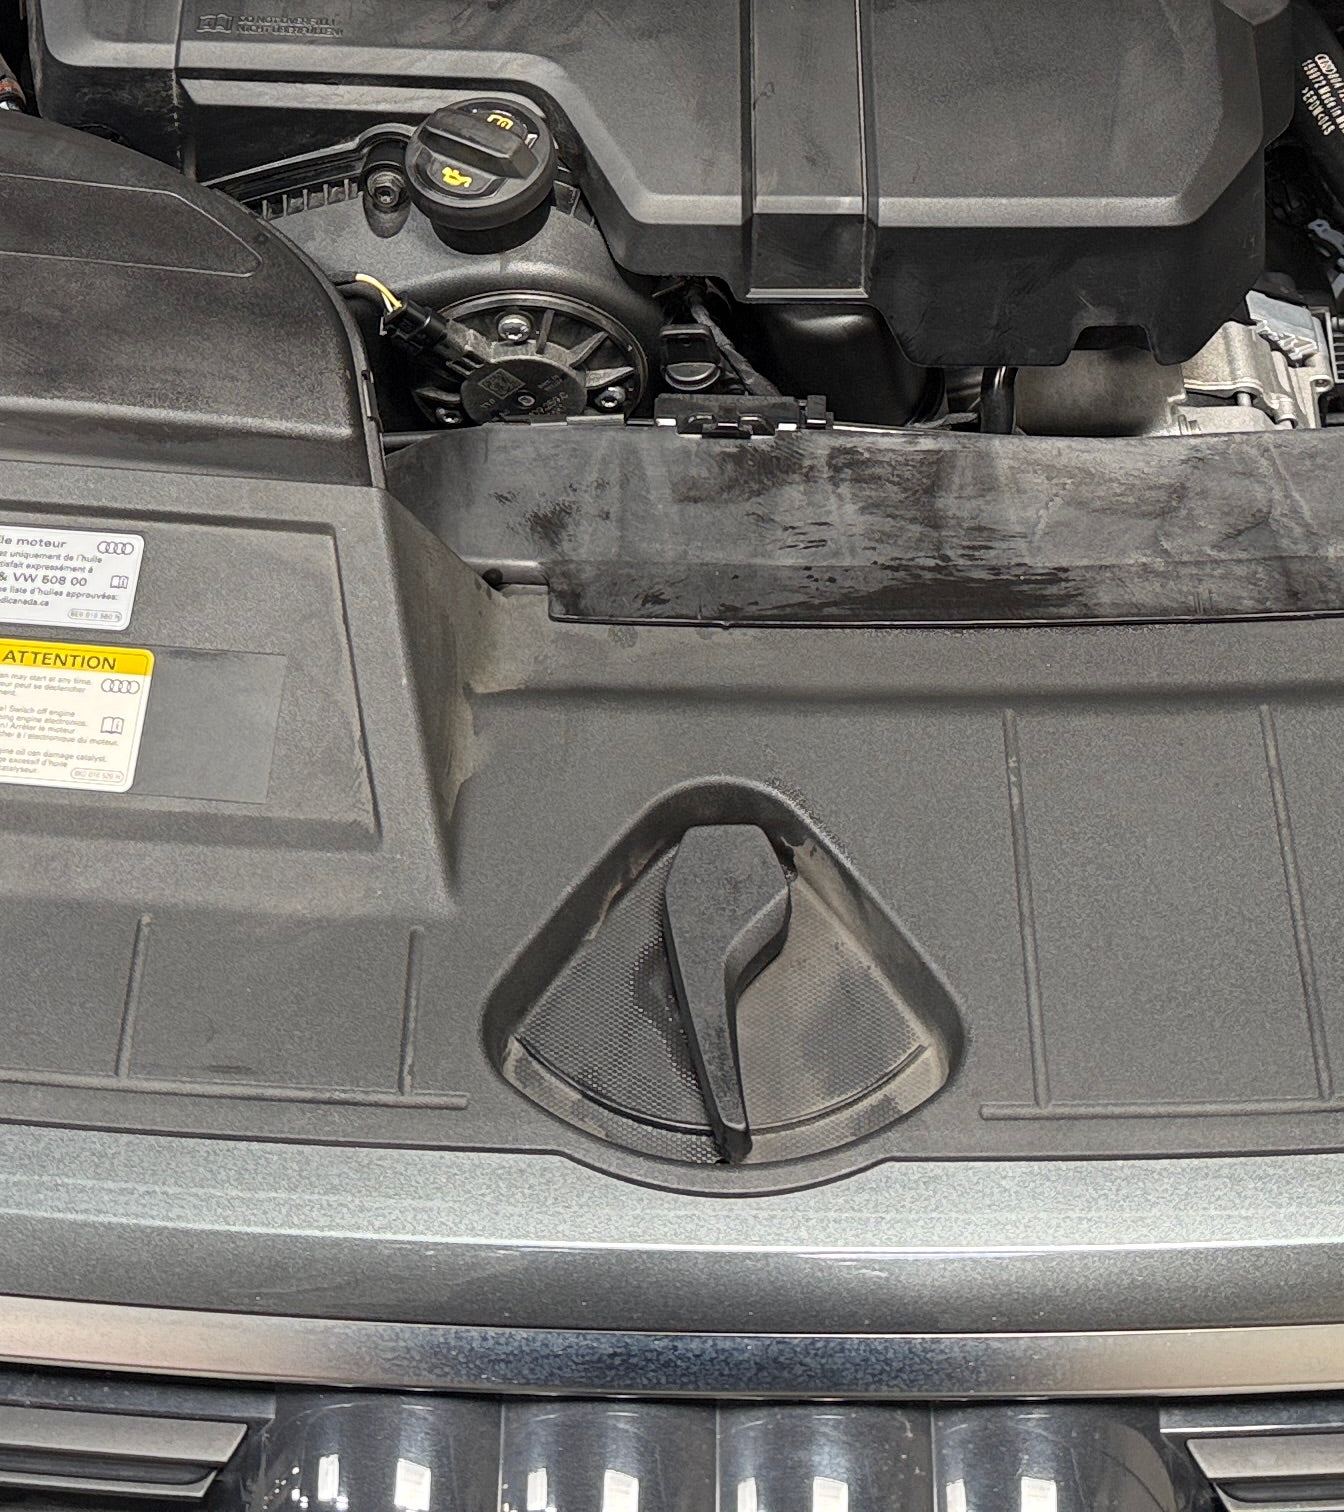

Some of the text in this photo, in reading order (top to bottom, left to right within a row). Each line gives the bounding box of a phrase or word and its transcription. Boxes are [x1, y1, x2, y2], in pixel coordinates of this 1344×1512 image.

[16, 538, 67, 548] moteur
[10, 551, 61, 561] uniquement
[63, 553, 74, 561] de
[88, 565, 93, 573] à
[13, 572, 38, 583] VW
[41, 574, 66, 586] 508
[70, 576, 88, 586] 00
[9, 585, 27, 594] liste
[30, 587, 63, 597] d'huiles
[2, 649, 117, 670] ATTENTION
